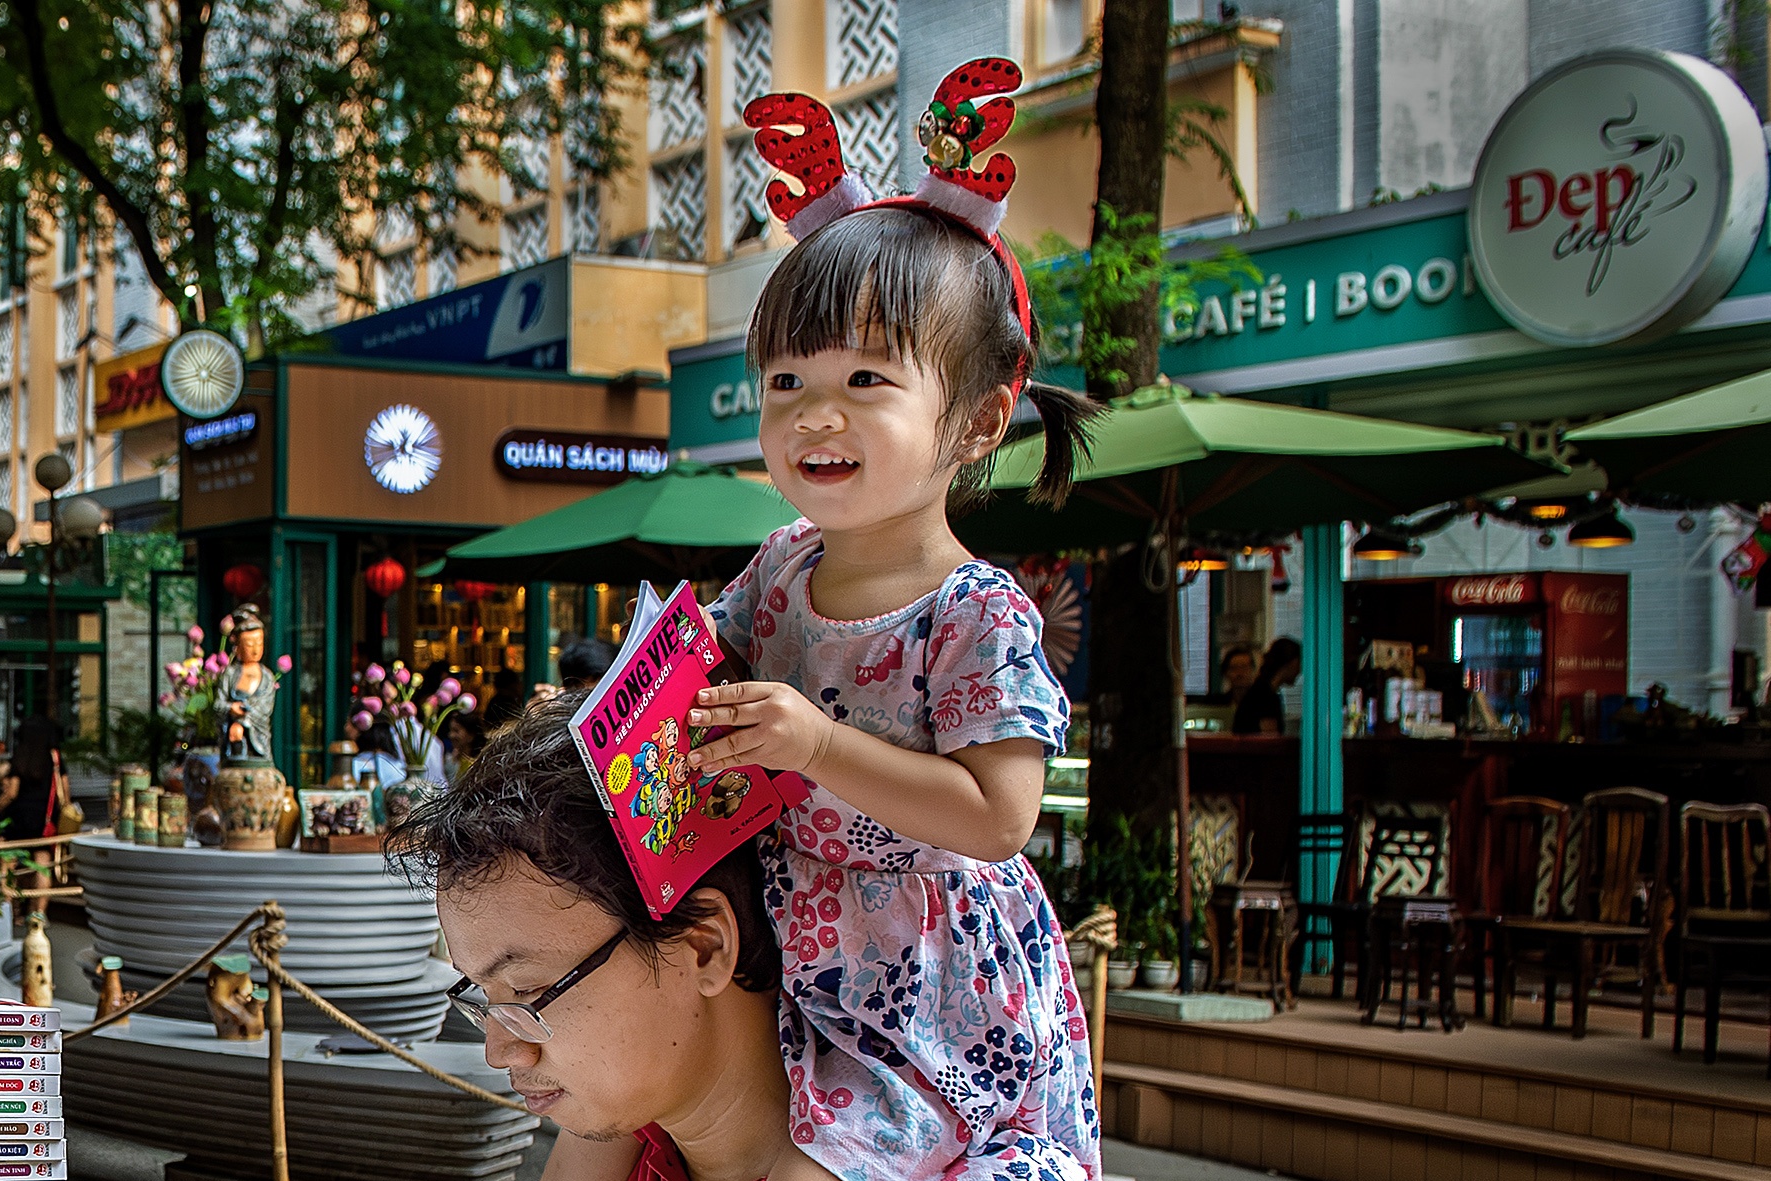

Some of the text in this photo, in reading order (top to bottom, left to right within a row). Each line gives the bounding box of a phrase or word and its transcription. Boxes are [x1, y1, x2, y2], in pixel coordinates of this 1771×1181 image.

[1163, 273, 1288, 343] CAFÉ
[1335, 252, 1478, 317] BOO
[503, 438, 565, 469] QUÁN
[566, 442, 625, 471] SÁCH
[703, 649, 715, 666] 8
[590, 716, 608, 750] Ô
[604, 657, 655, 729] LONG
[615, 716, 634, 746] SIÊU
